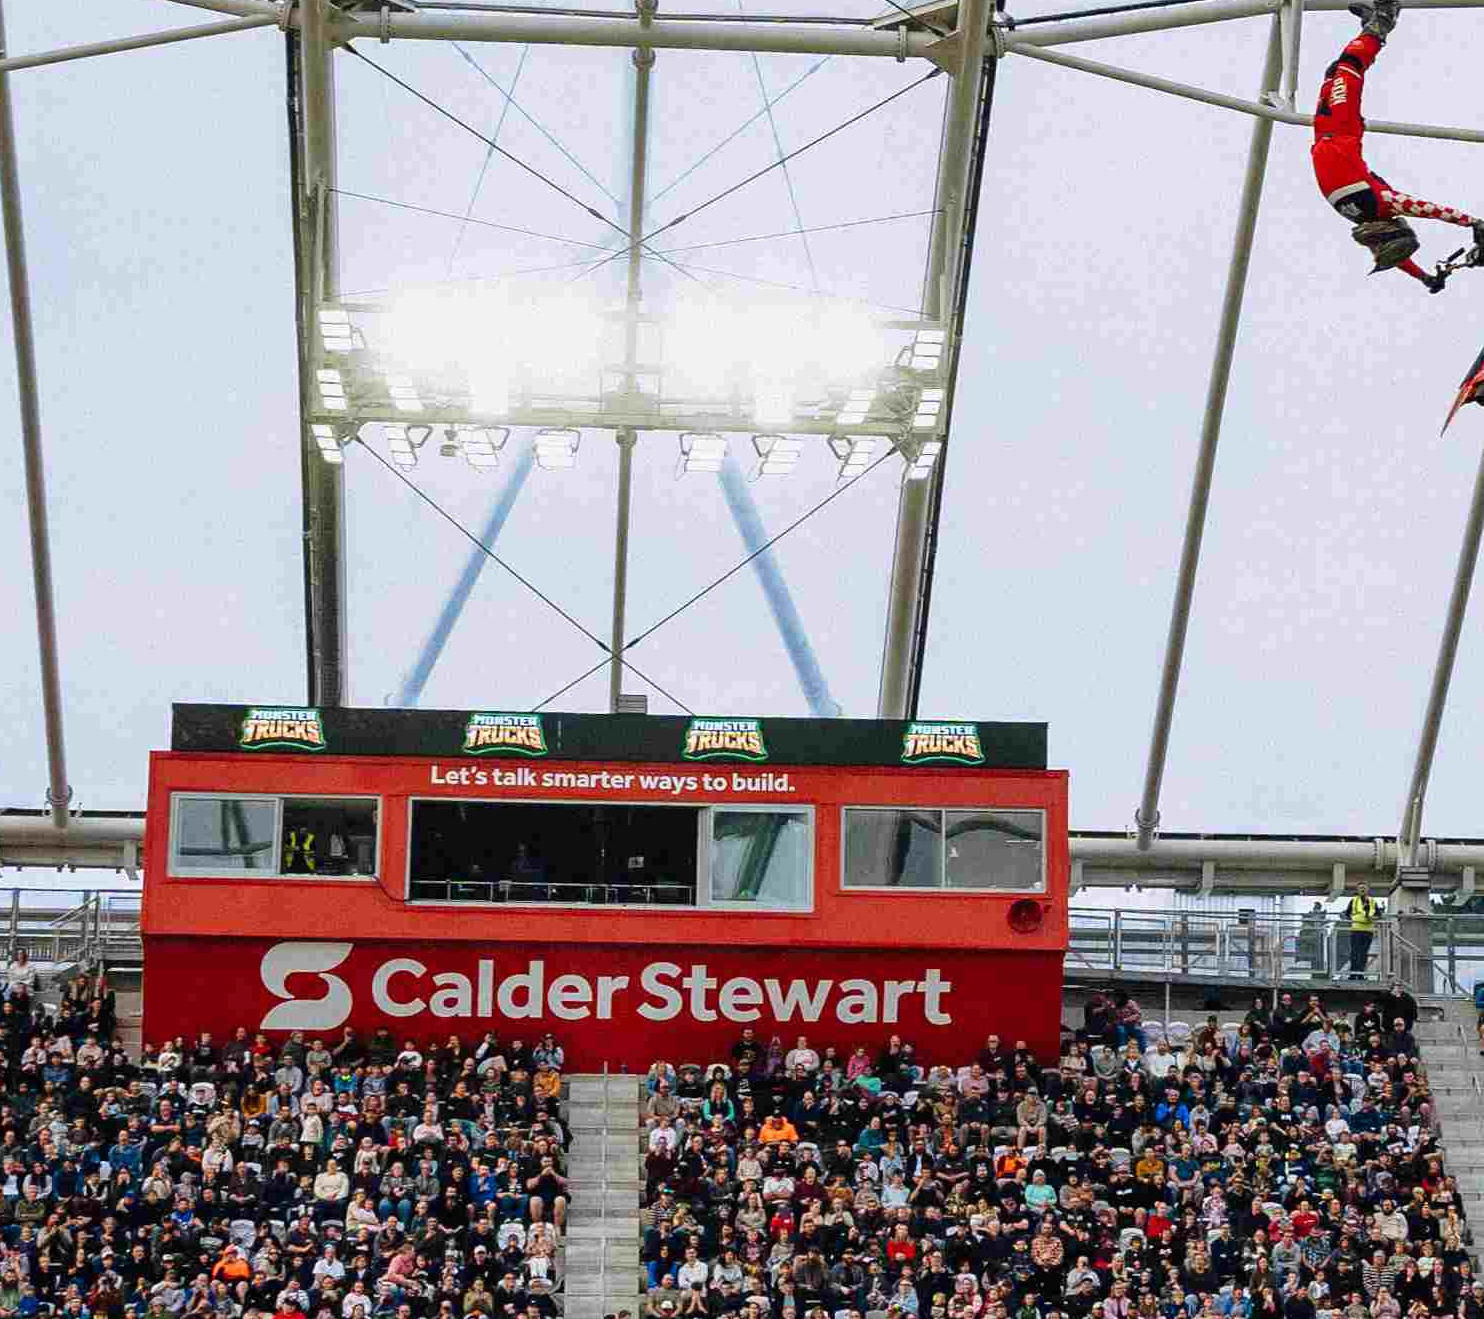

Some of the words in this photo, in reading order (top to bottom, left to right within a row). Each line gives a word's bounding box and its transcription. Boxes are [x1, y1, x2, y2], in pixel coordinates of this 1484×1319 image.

[251, 709, 317, 720] MONSTER
[473, 713, 537, 725] MONSTER
[693, 719, 756, 731] MONSTER
[243, 719, 321, 744] TRUCKS
[466, 724, 543, 747] TRUCKS
[910, 724, 976, 734] MONSTER
[686, 730, 762, 751] TRUCKS
[903, 734, 981, 756] TRUCKS
[430, 764, 488, 787] Let's
[492, 766, 538, 788] talk
[541, 770, 635, 792] smarter
[638, 773, 700, 795] ways
[701, 773, 727, 792] to
[731, 772, 796, 793] build.
[371, 957, 628, 1020] Calder
[637, 960, 953, 1026] Stewart
